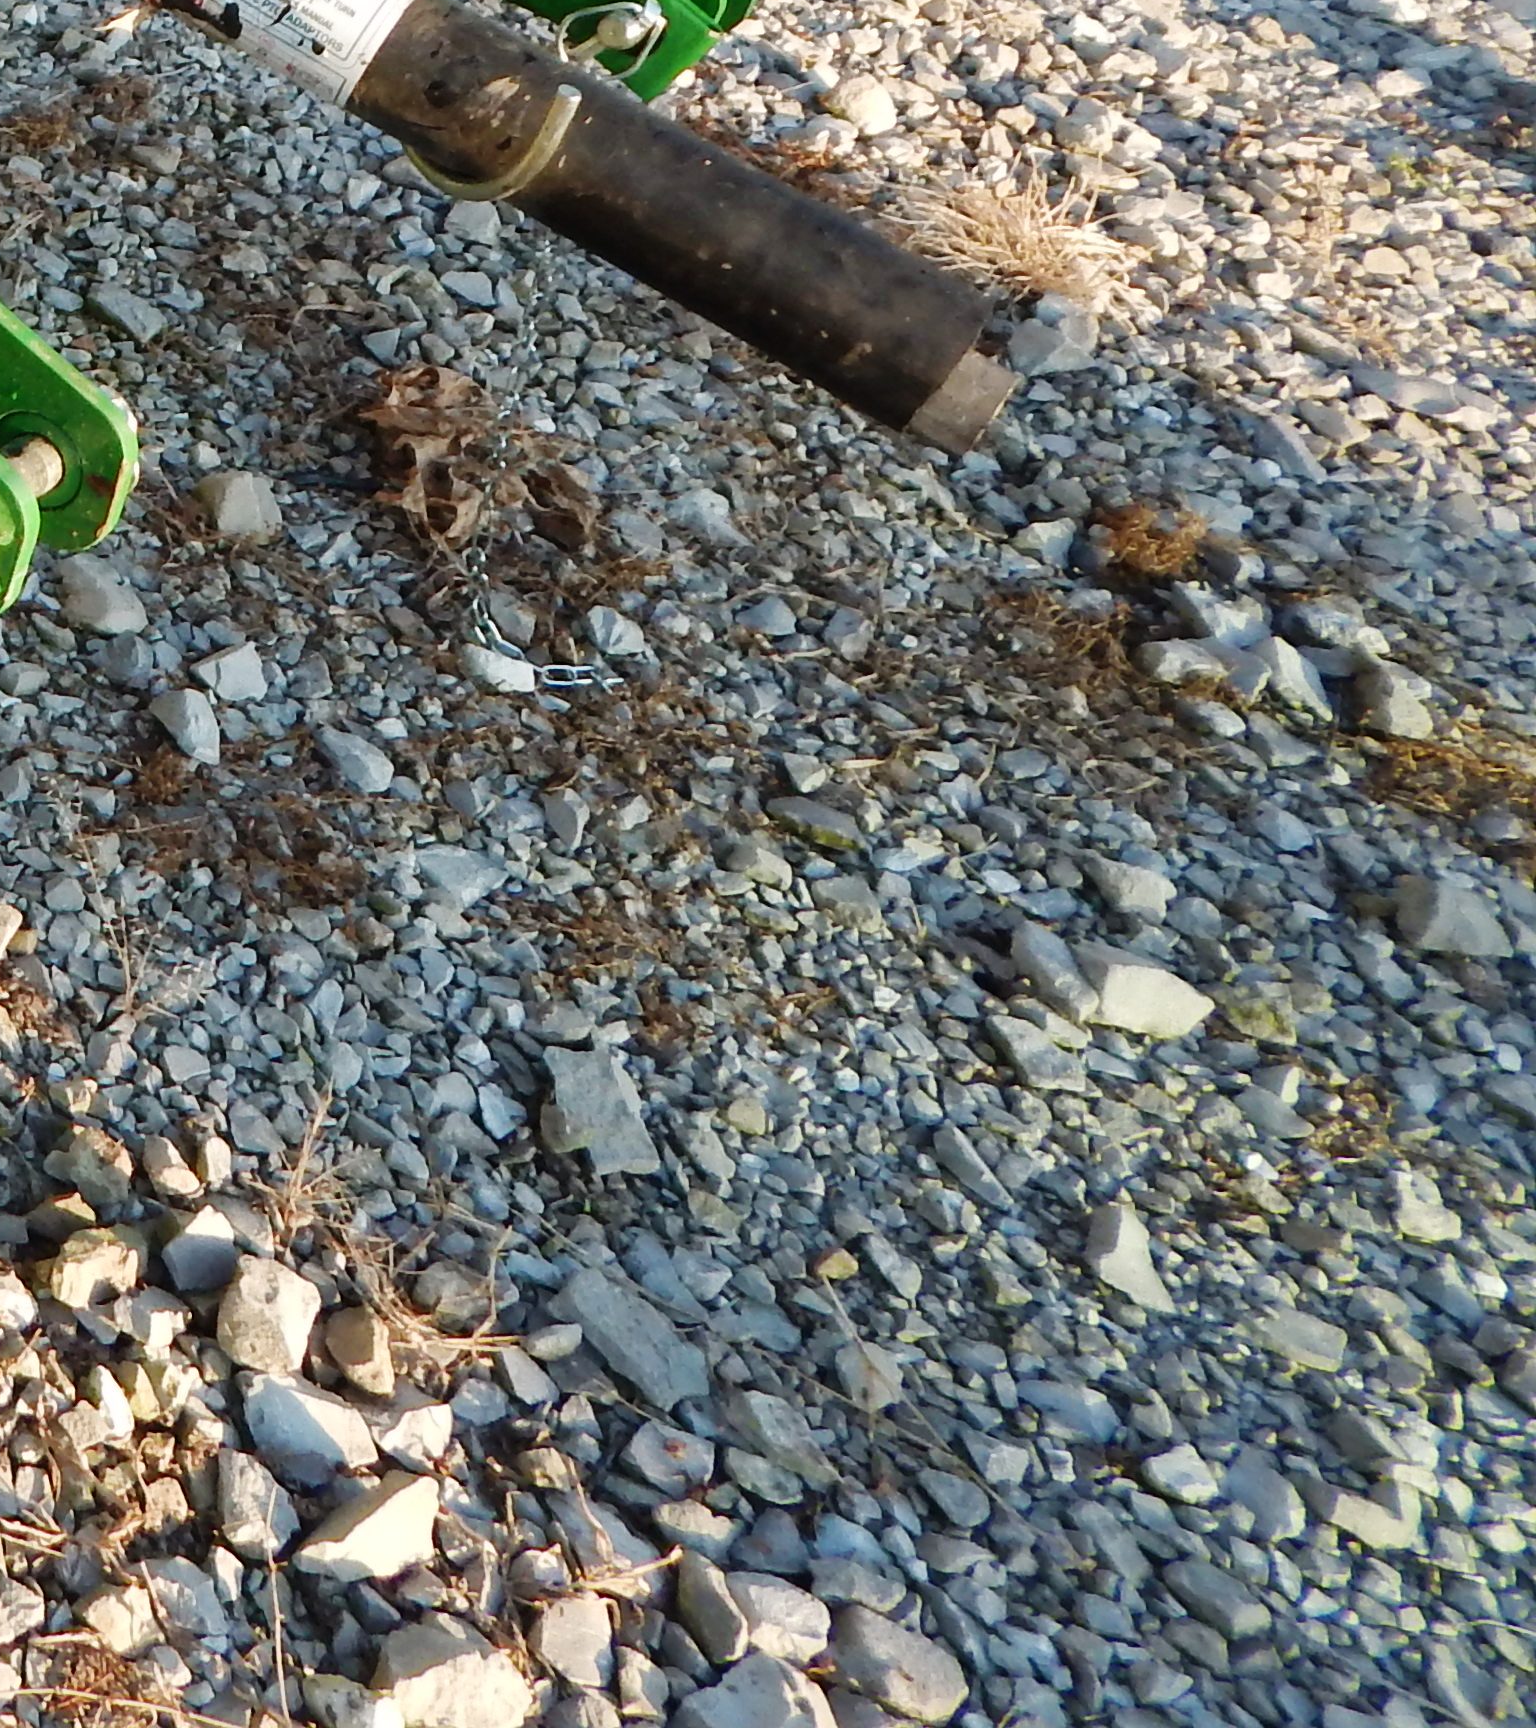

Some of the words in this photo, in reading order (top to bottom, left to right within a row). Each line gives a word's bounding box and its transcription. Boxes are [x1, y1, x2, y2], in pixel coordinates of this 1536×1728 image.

[299, 5, 335, 30] MANUAL
[333, 0, 357, 18] TURN
[284, 12, 345, 53] ADAPTORS
